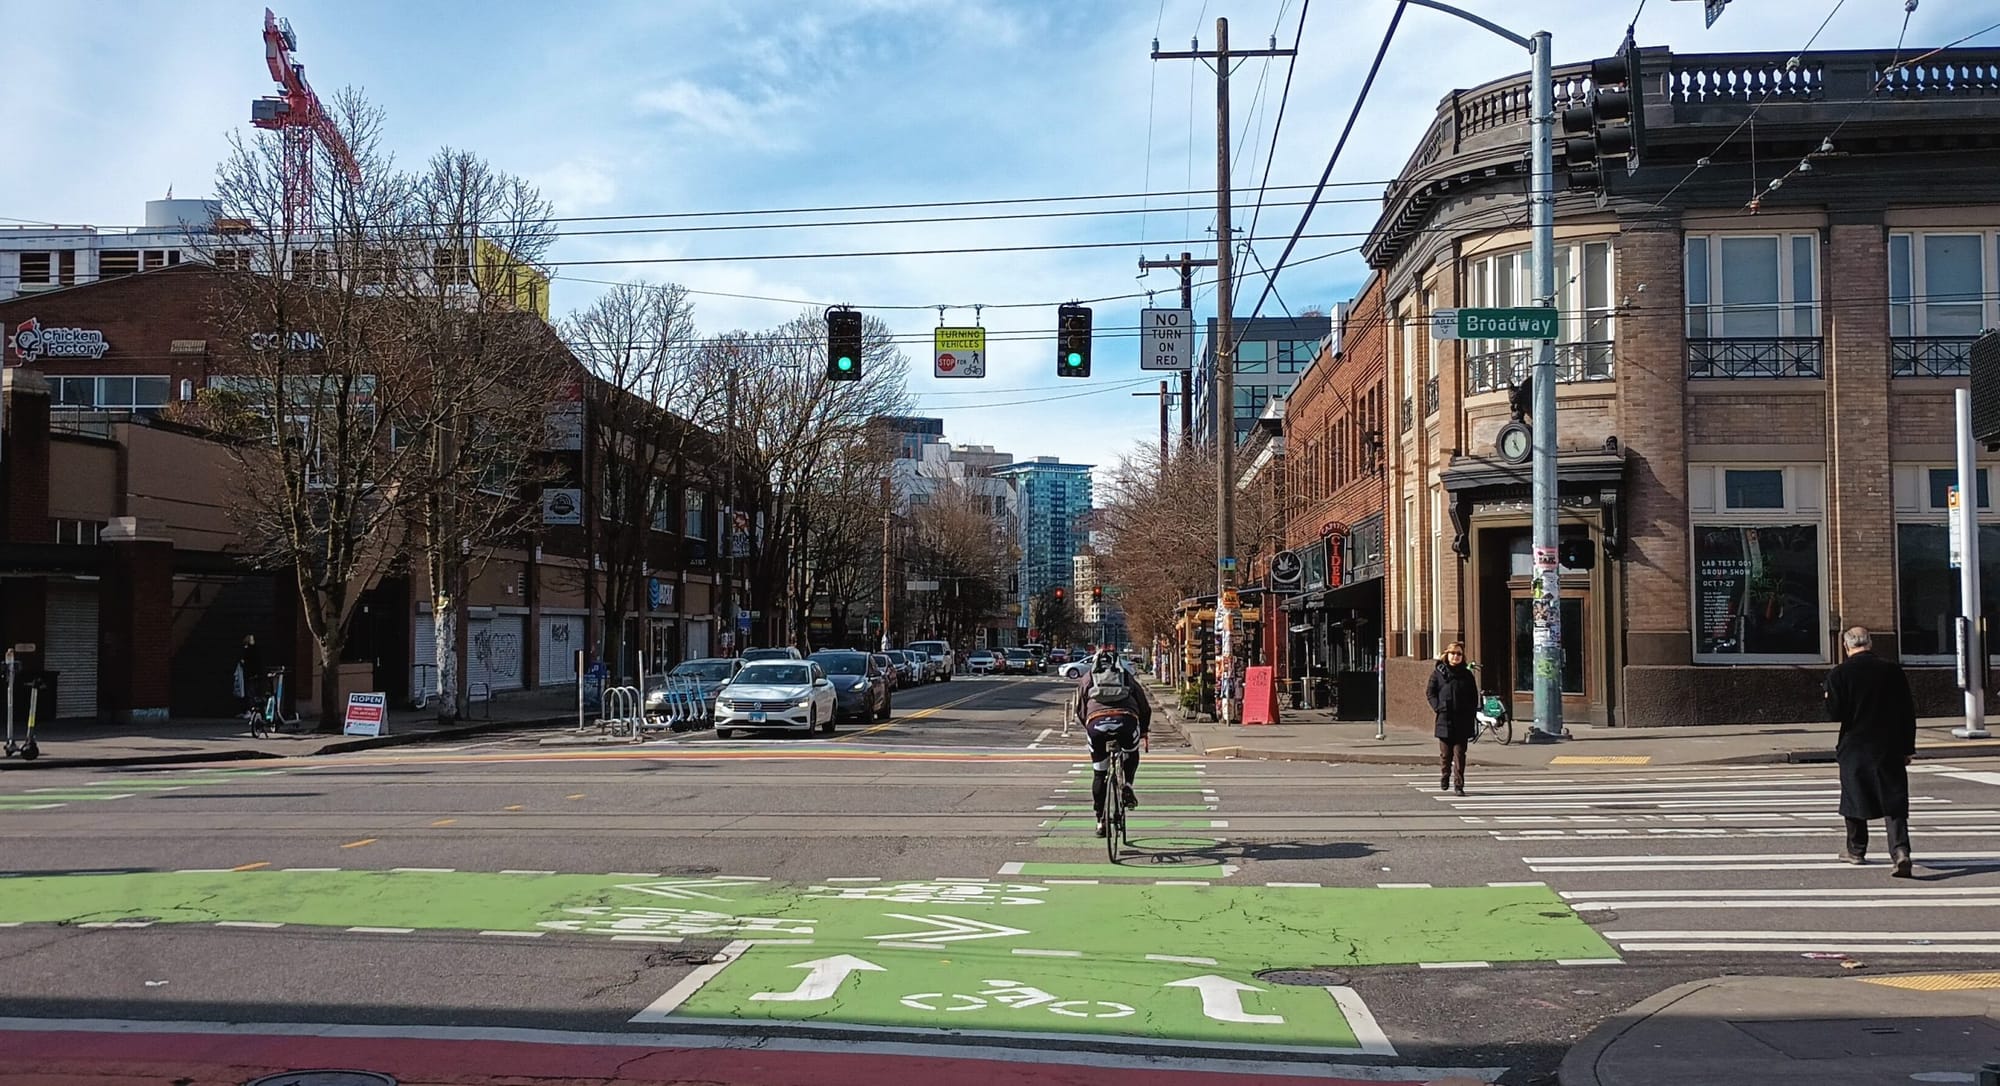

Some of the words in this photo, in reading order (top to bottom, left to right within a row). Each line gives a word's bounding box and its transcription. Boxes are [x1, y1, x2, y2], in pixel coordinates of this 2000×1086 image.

[1156, 313, 1178, 326] NO
[1467, 315, 1551, 335] Broadway
[42, 329, 97, 342] Chicken
[939, 330, 980, 339] TURNING
[1151, 329, 1182, 339] TURN
[48, 342, 104, 357] Factory
[941, 340, 979, 348] VEHICLES
[1159, 342, 1175, 352] ON
[1156, 355, 1178, 366] RED
[1321, 522, 1349, 535] CAPITOL
[1331, 535, 1341, 586] CIDER
[1701, 568, 1728, 576] GROUP
[1730, 568, 1751, 576] SHOW
